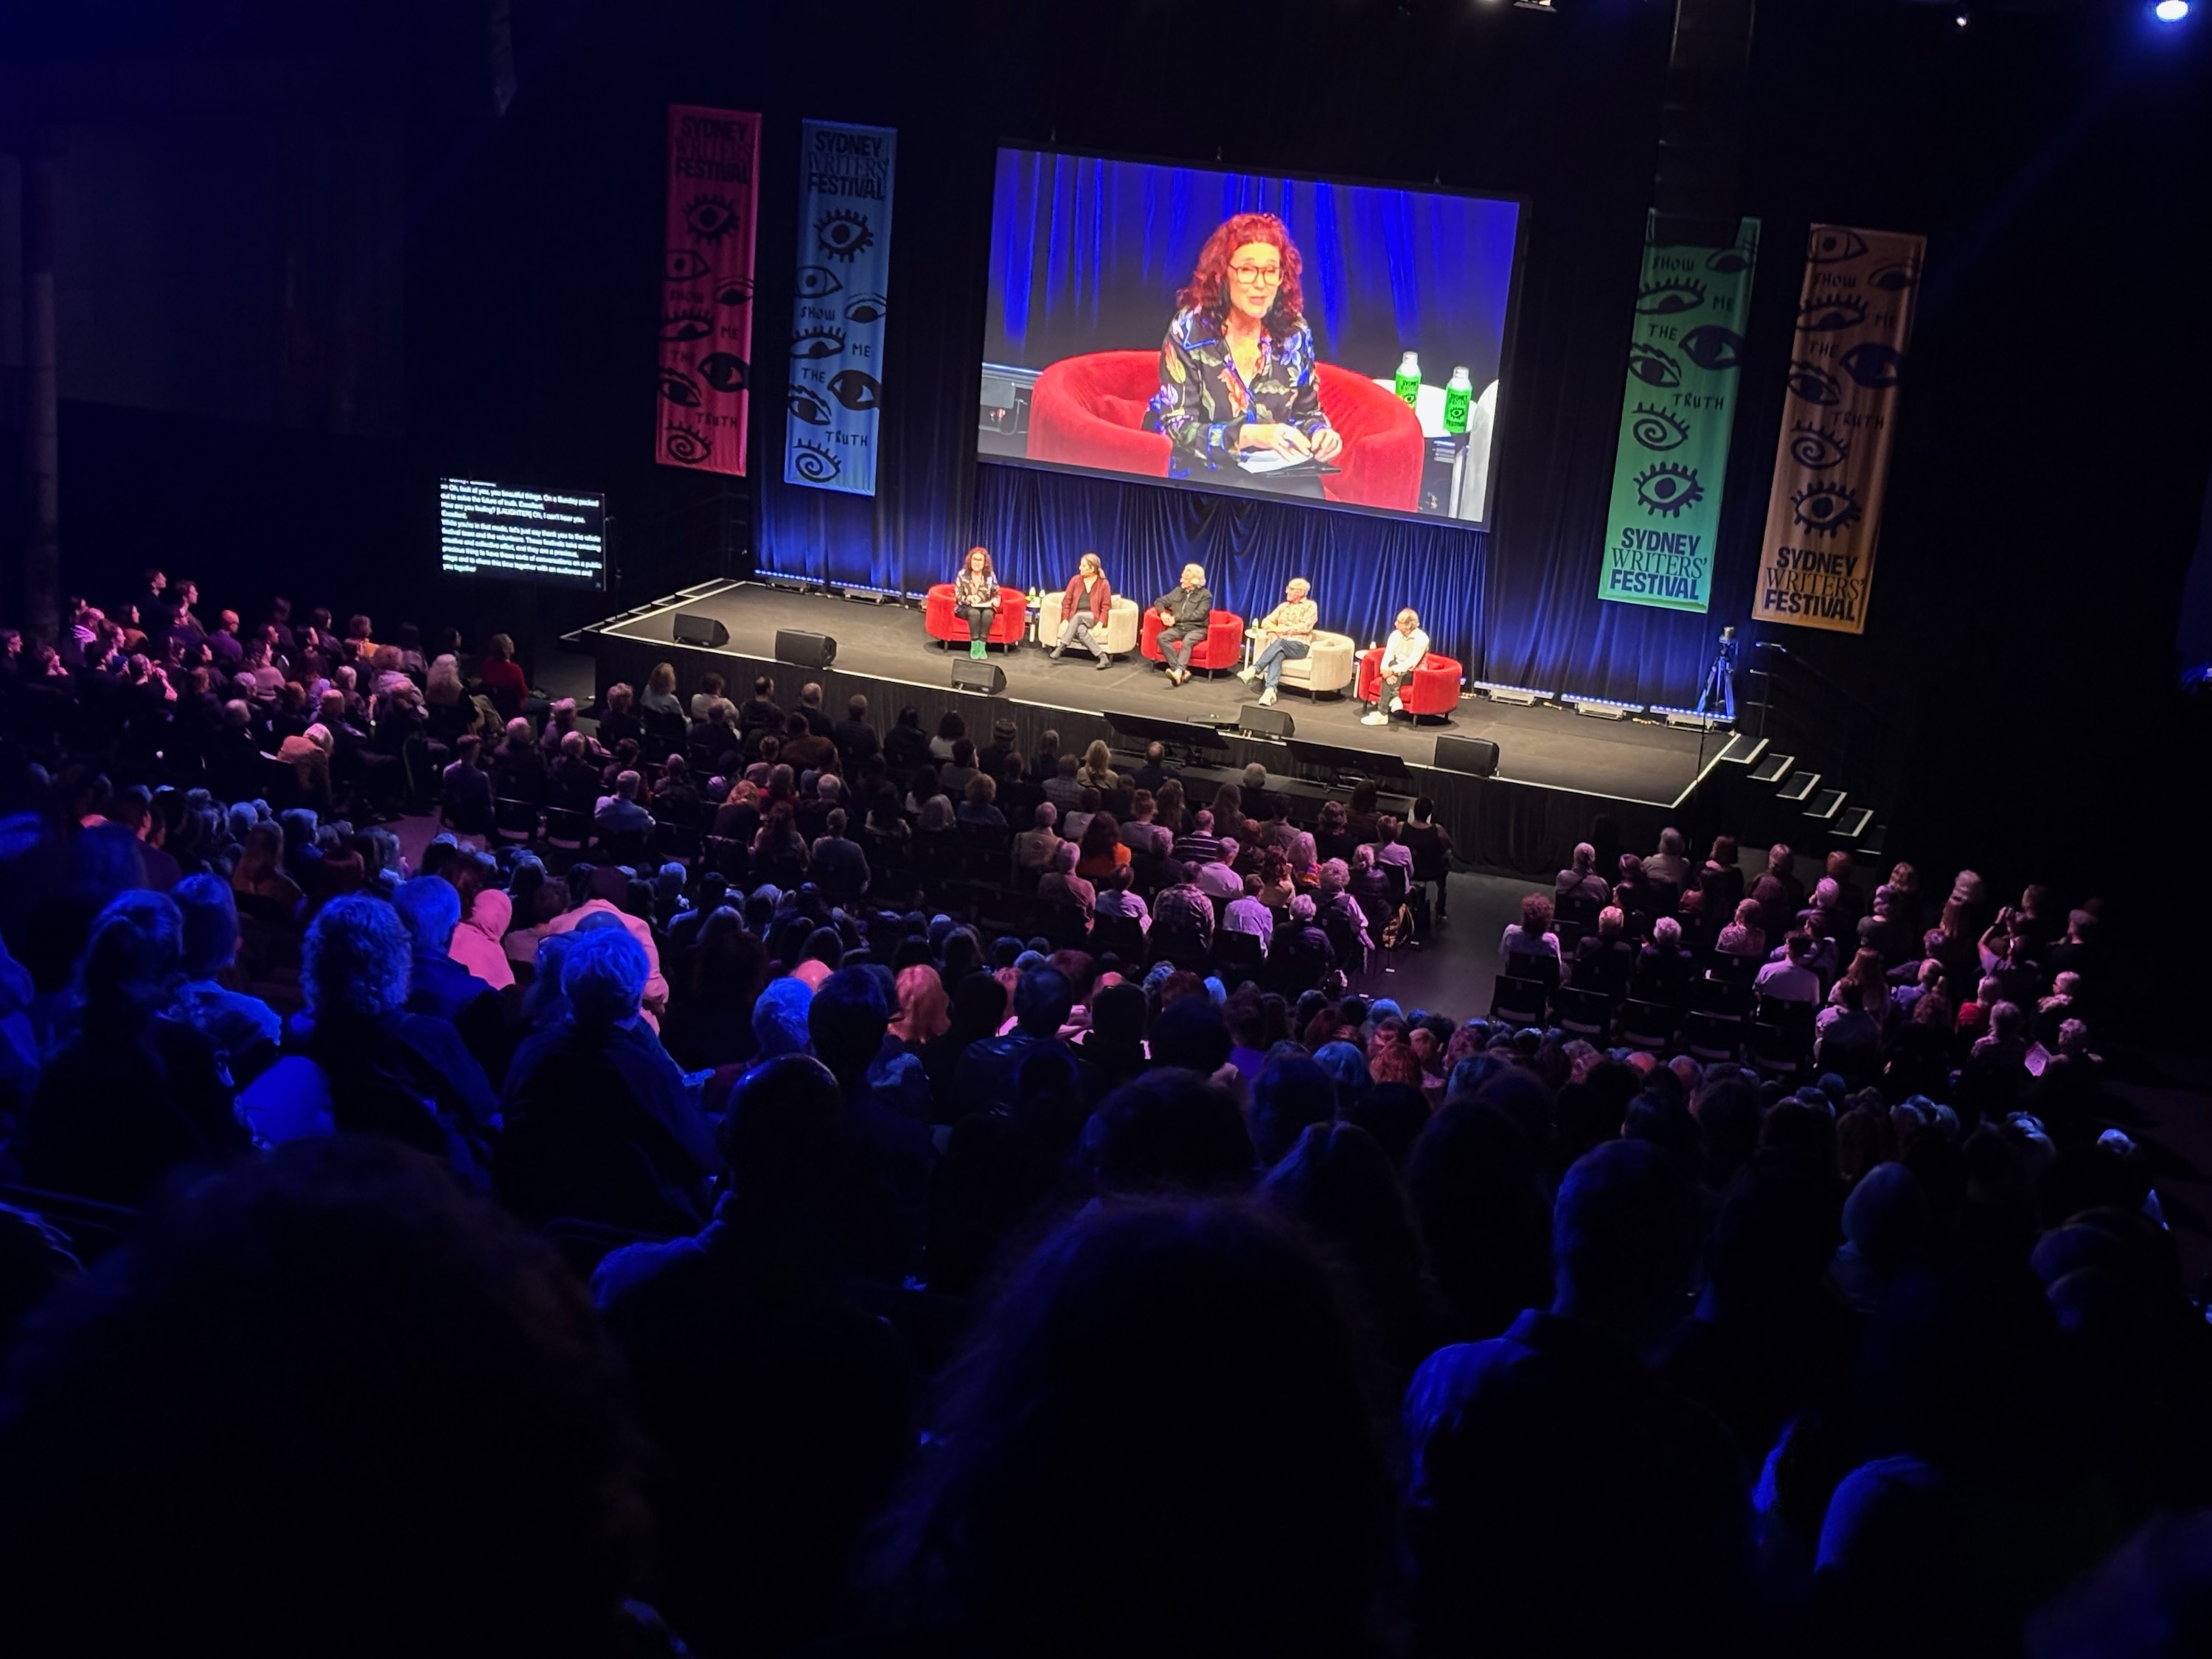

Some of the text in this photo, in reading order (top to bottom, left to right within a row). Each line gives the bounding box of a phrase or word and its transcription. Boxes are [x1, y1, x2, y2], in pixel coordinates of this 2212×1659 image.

[681, 115, 748, 142] SYDNEY
[815, 131, 883, 157] SYDNEY
[676, 156, 751, 184] FESTIVAL
[808, 173, 884, 200] FESTIVAL
[1652, 255, 1694, 271] SHOW
[1812, 272, 1857, 288] SHOW
[669, 289, 704, 304] SHOW
[1713, 296, 1733, 312] ME
[800, 306, 835, 320] SHOW
[1875, 314, 1897, 330] ME
[721, 326, 738, 340] ME
[1649, 324, 1677, 341] THE
[672, 350, 695, 366] THE
[852, 343, 871, 358] ME
[1809, 341, 1838, 358] THE
[802, 368, 825, 383] THE
[1672, 394, 1725, 410] TRUTH
[696, 411, 738, 428] TRUTH
[1833, 411, 1885, 429] TRUTH
[825, 431, 868, 447] TRUTH
[1621, 527, 1701, 556] SYDNEY
[1611, 547, 1708, 579] WRITERS'
[1776, 546, 1858, 577] SYDNEY
[1610, 568, 1699, 600] FESTIVAL
[1767, 567, 1867, 601] WRITERS'
[1764, 588, 1855, 621] FESTIVAL
